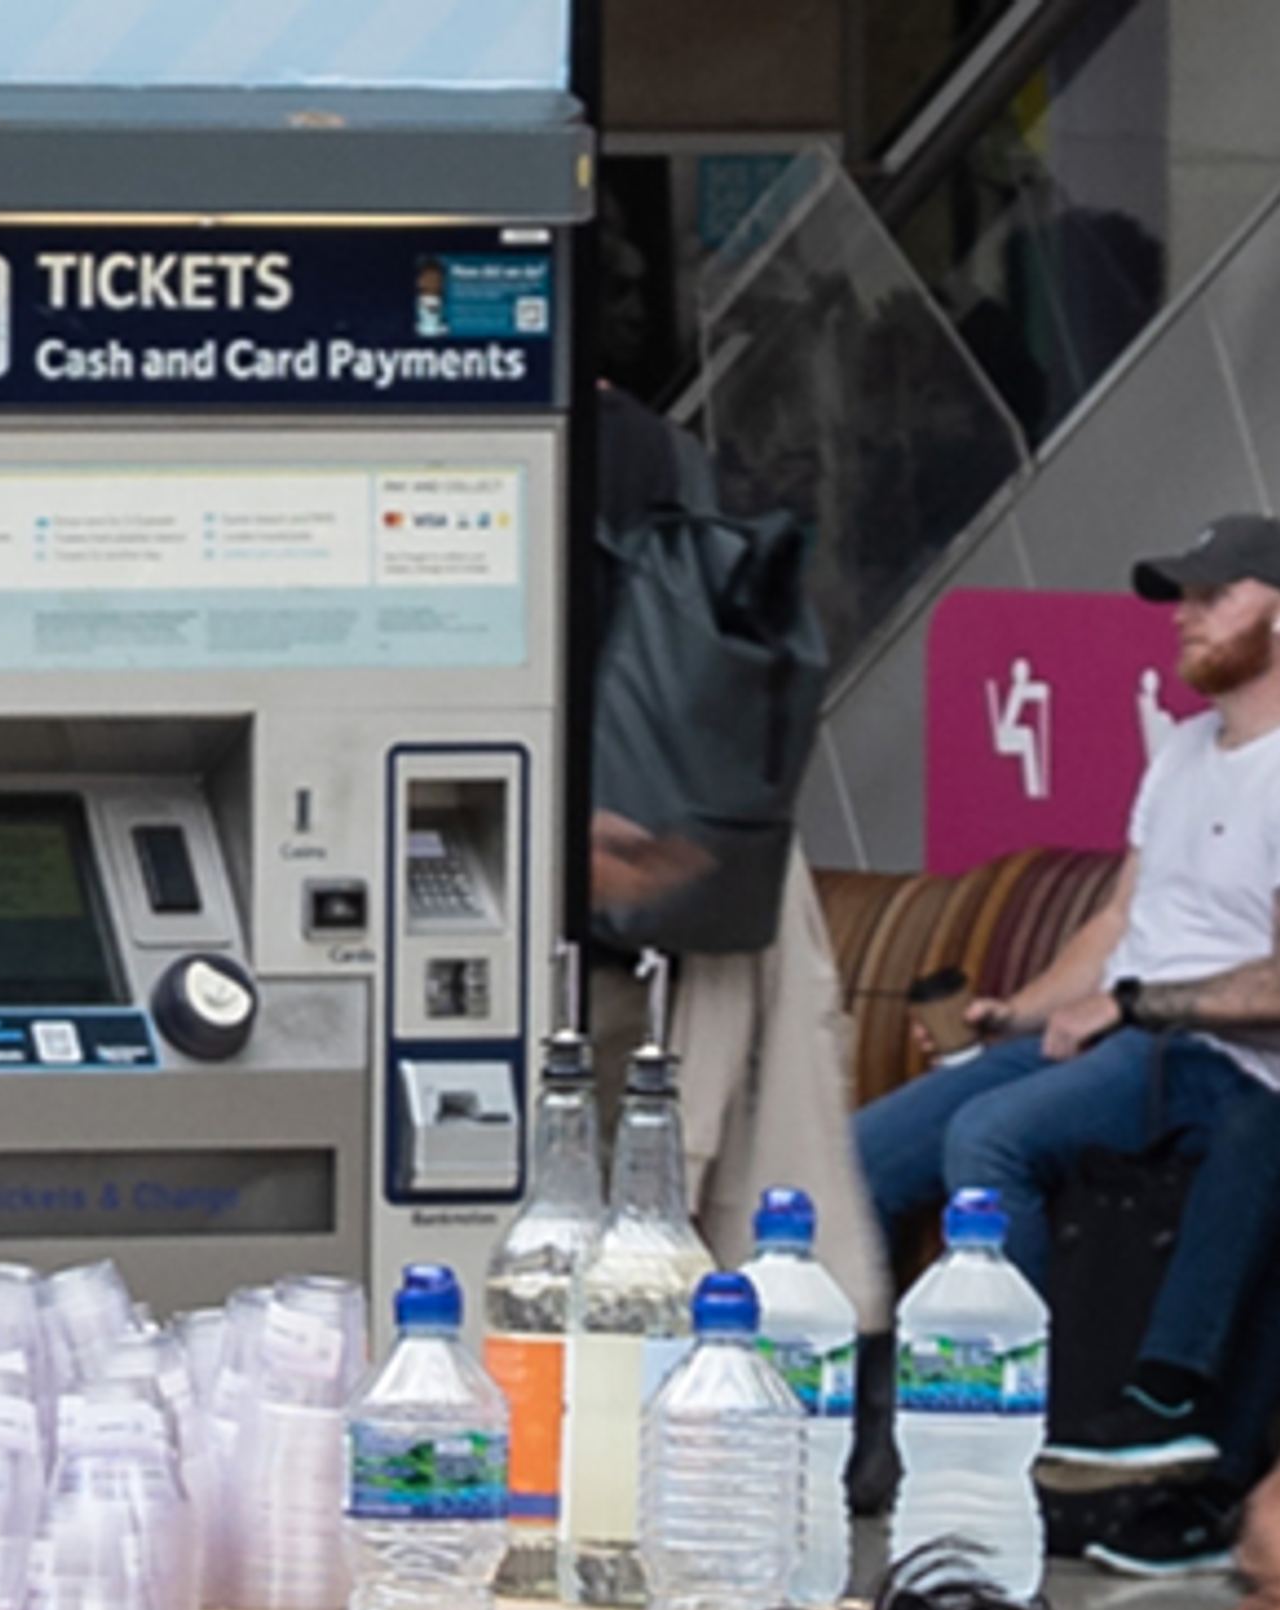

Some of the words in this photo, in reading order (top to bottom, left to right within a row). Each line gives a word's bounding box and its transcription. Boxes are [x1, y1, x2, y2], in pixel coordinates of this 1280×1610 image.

[38, 253, 293, 310] TICKETS
[36, 339, 134, 380] Cash
[141, 339, 216, 380] and
[224, 339, 319, 380] Card
[328, 339, 526, 389] Payments
[101, 1183, 120, 1210] &
[132, 1182, 240, 1217] Change
